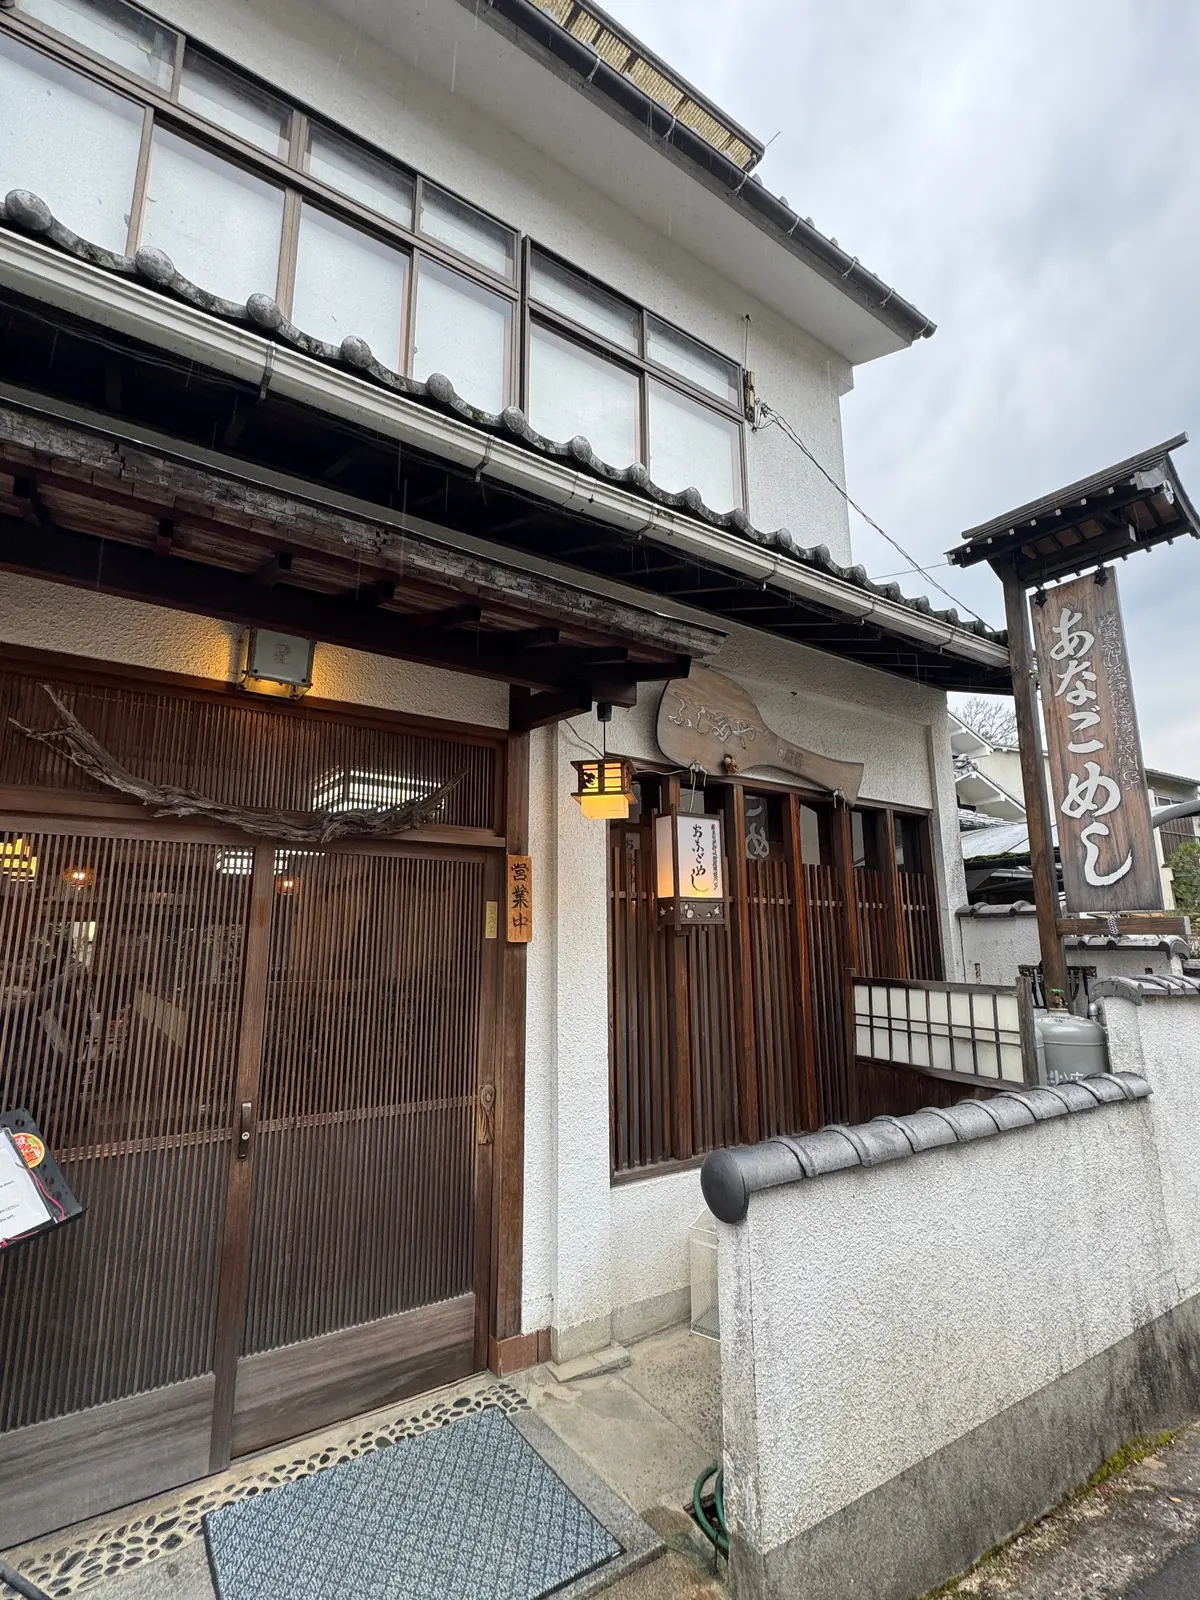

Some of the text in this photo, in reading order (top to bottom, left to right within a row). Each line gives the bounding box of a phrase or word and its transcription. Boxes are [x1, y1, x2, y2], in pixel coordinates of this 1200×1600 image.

[1050, 607, 1133, 887] あなごめし
[510, 862, 529, 936] 営業中
